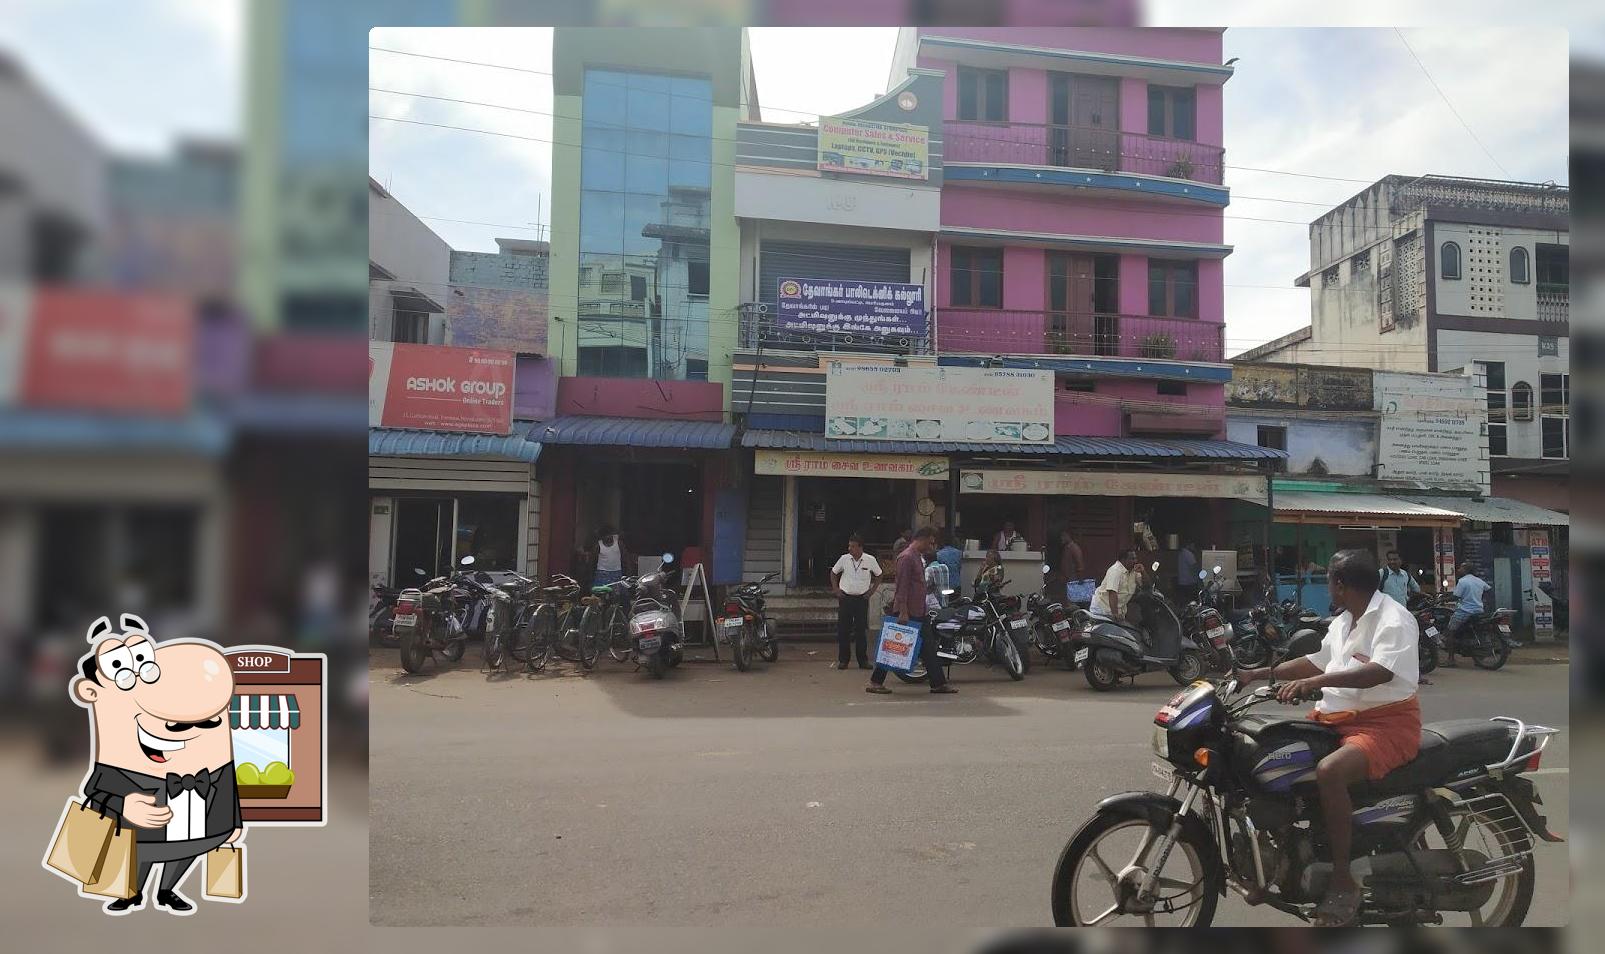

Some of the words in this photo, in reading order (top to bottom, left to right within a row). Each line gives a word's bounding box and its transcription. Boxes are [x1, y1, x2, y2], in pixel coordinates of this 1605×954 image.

[823, 124, 862, 137] Computer
[865, 129, 887, 139] Sales
[895, 133, 926, 144] Service
[894, 286, 922, 306] கல்லூரி
[406, 376, 455, 392] ASHOK
[803, 456, 828, 470] ராம்
[831, 460, 858, 471] சைவ
[1268, 751, 1292, 760] Hero
